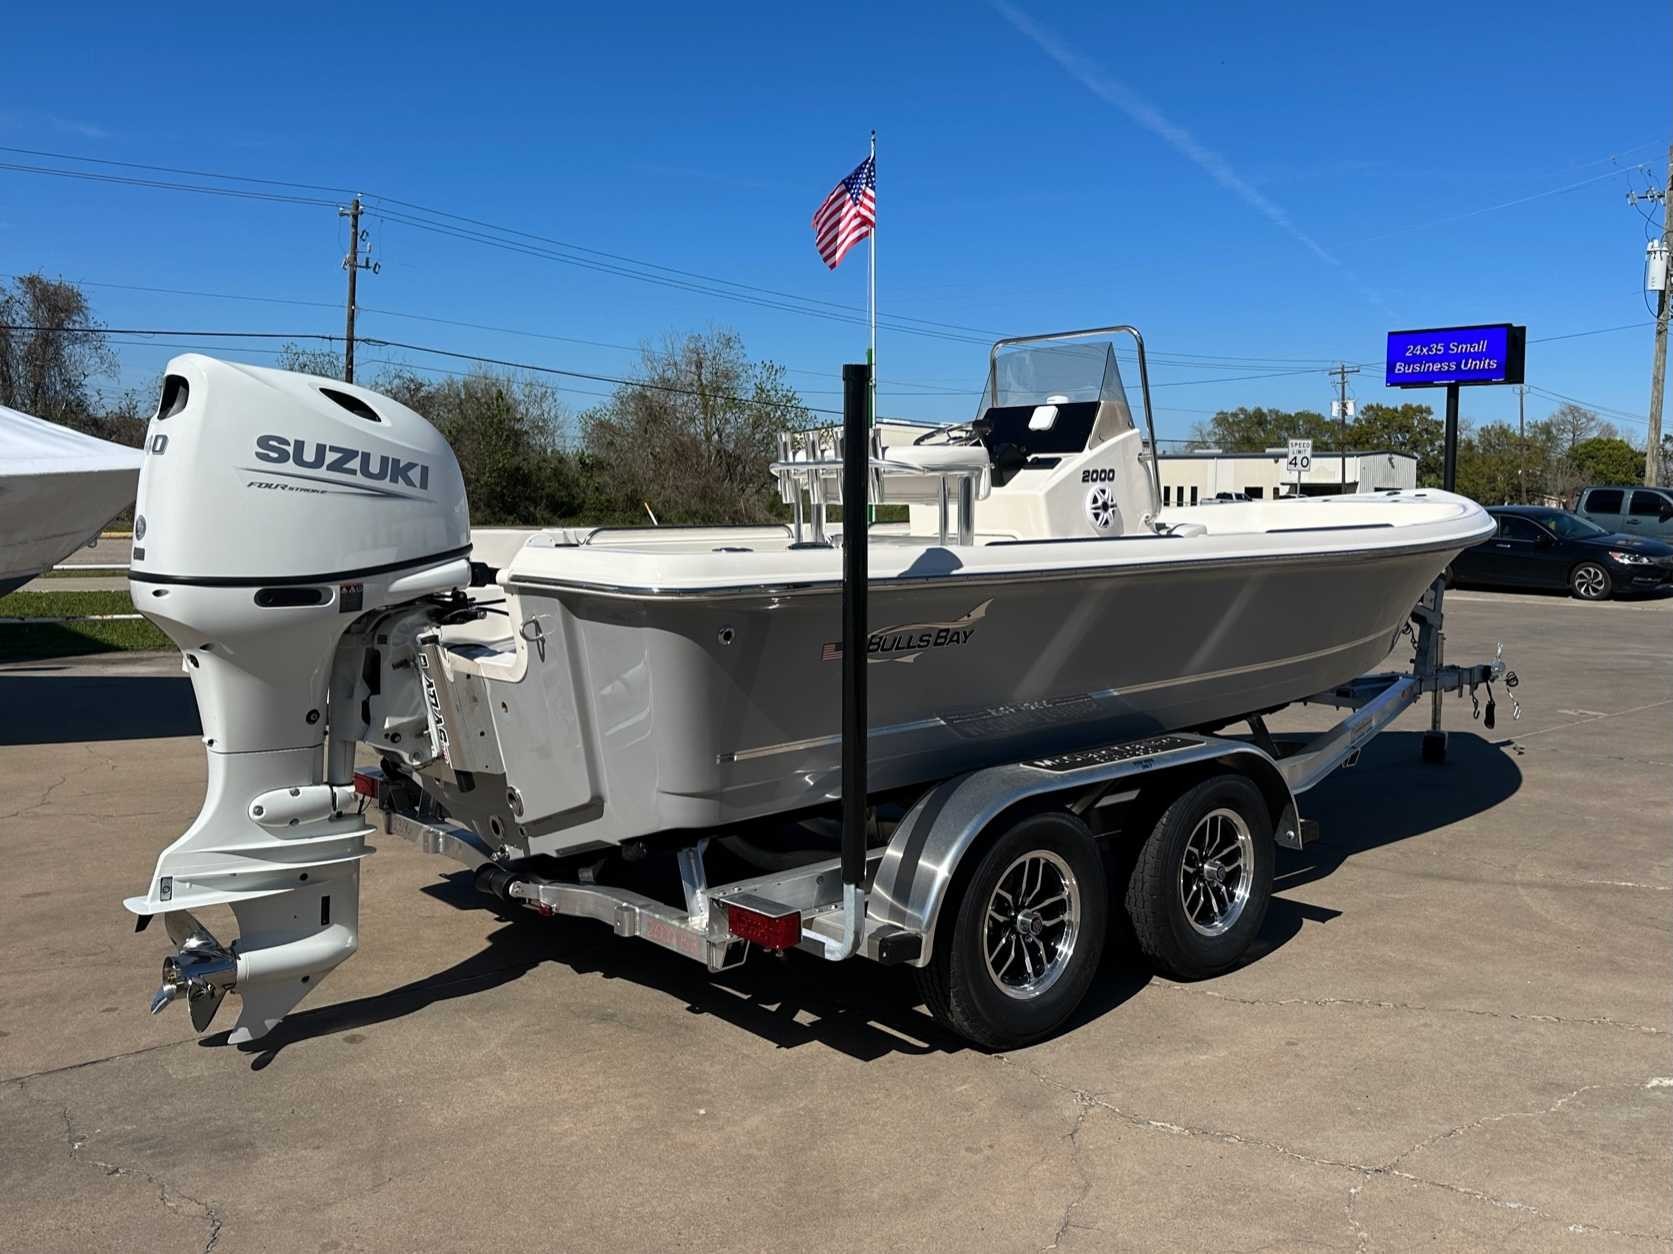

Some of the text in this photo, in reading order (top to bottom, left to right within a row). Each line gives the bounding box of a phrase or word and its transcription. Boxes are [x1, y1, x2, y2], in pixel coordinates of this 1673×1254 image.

[1405, 340, 1488, 357] 24x35 Small
[1394, 357, 1498, 374] Business Units
[254, 434, 429, 490] SUZUKI
[1288, 455, 1310, 468] 40
[1081, 468, 1115, 483] 2000
[247, 481, 288, 490] FOUR
[867, 628, 975, 653] BULLS BAY
